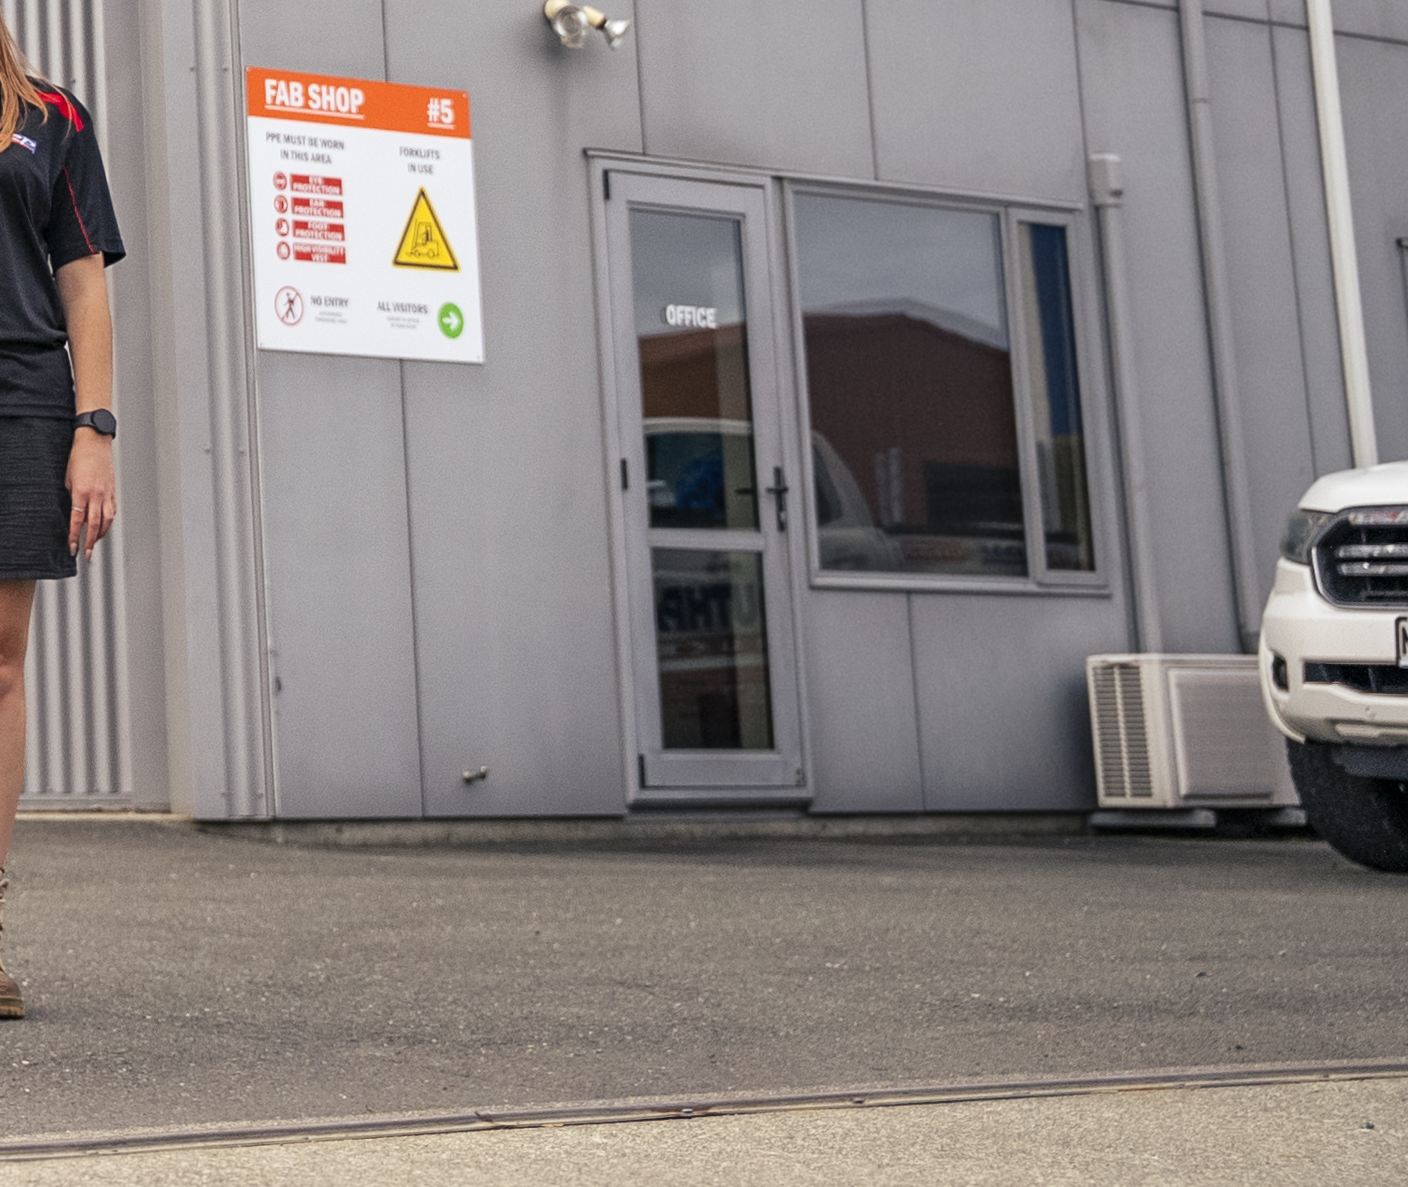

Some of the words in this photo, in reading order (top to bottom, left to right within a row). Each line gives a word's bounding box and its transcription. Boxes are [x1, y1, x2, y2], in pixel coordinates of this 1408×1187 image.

[265, 79, 304, 108] FAB
[307, 84, 364, 114] SHOP
[427, 98, 454, 124] #5
[266, 132, 281, 143] PPE
[283, 134, 306, 145] MUST
[308, 136, 318, 148] BE
[320, 138, 345, 150] WORN
[280, 150, 289, 160] IN
[290, 151, 309, 162] THIS
[310, 153, 332, 164] AREA
[399, 146, 440, 160] FORKLIFTS
[407, 162, 416, 173] IN
[418, 164, 434, 175] USE
[293, 183, 340, 194] PROTECTION
[294, 206, 341, 217] PROTECTION
[295, 229, 343, 241] PROTECTION
[310, 295, 322, 306] NO
[324, 296, 349, 308] ENTRY
[377, 301, 391, 312] ALL
[392, 302, 428, 314] VISITORS
[666, 303, 717, 329] OFFICE
